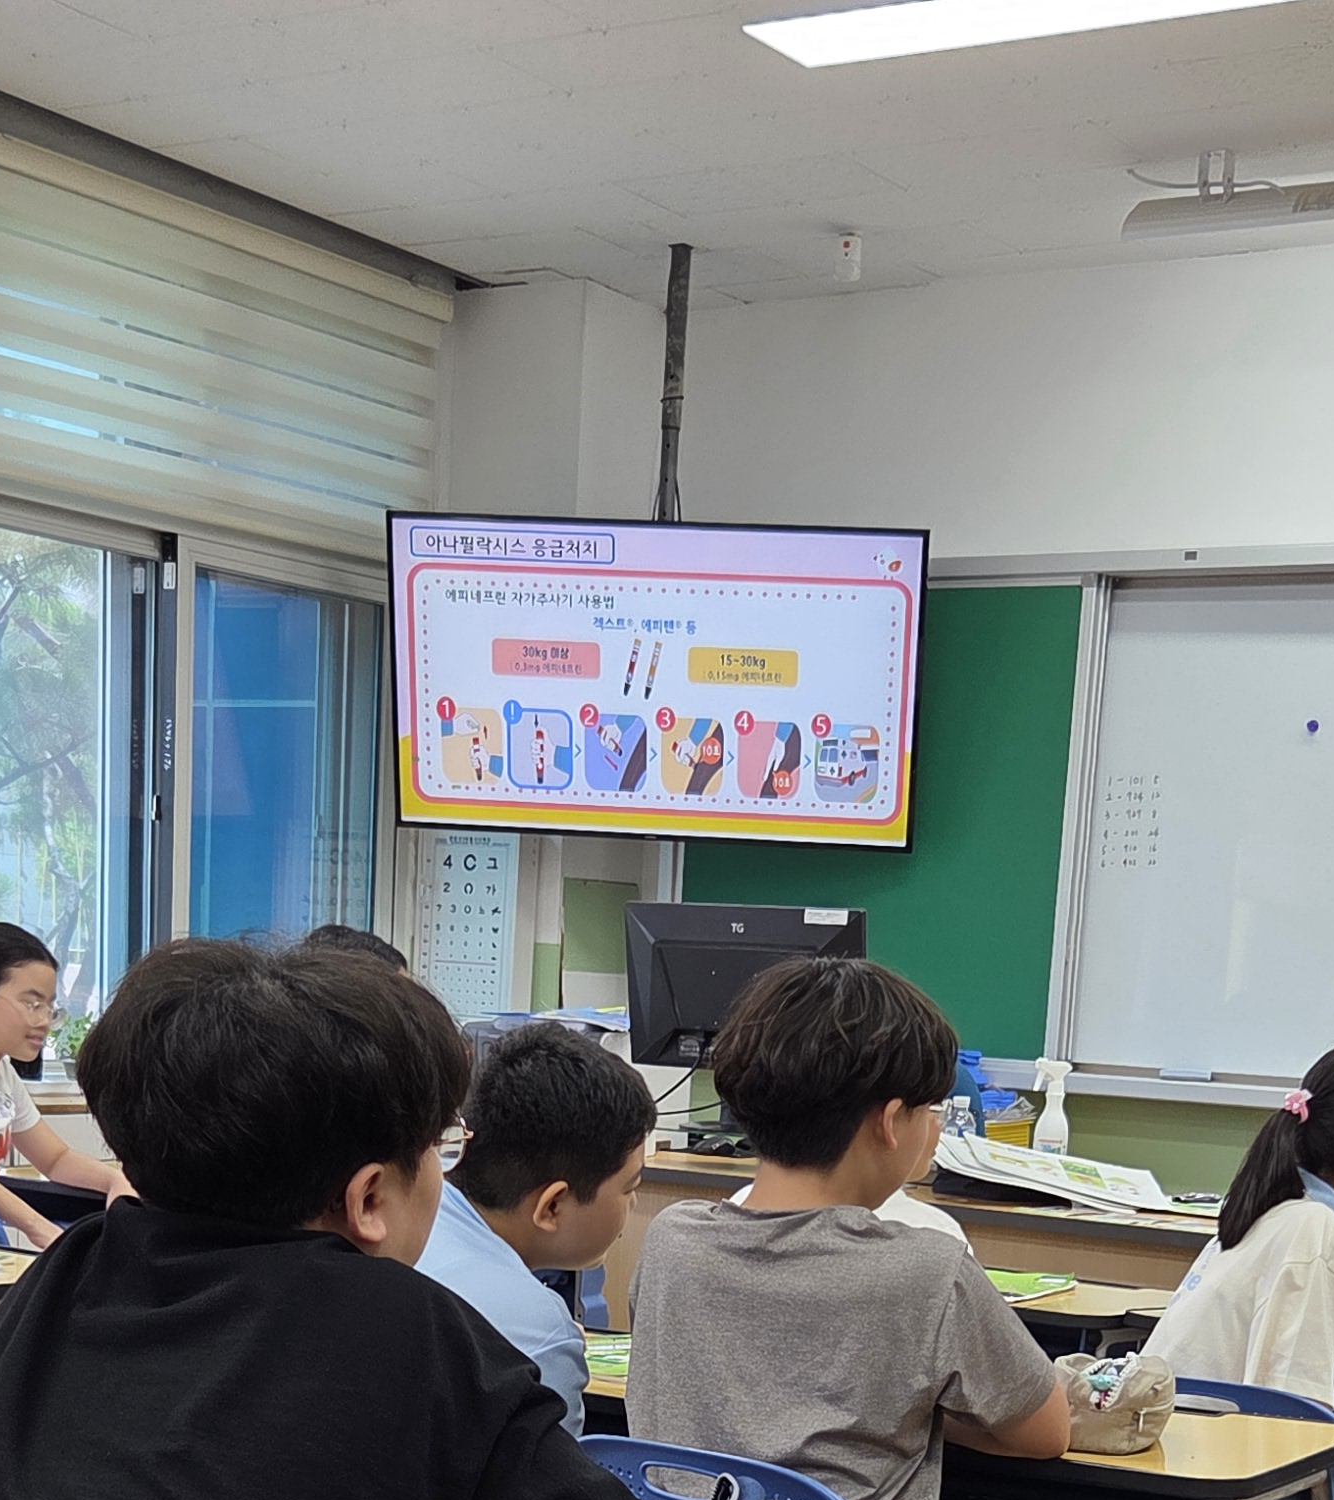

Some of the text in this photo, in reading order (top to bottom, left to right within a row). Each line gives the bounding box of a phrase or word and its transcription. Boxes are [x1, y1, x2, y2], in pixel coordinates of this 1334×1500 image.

[425, 534, 598, 559] 아나필락시스 응급처치
[445, 589, 615, 610] 에피네프린 자가주사기 사용법
[685, 620, 697, 635] 등
[522, 645, 547, 661] 30kg
[441, 700, 452, 719] 1
[584, 706, 595, 726] 2
[661, 711, 672, 728] 3
[737, 713, 750, 731] 4
[816, 716, 828, 736] 5
[443, 854, 453, 870] 4
[443, 882, 451, 893] 2
[730, 922, 745, 934] TG
